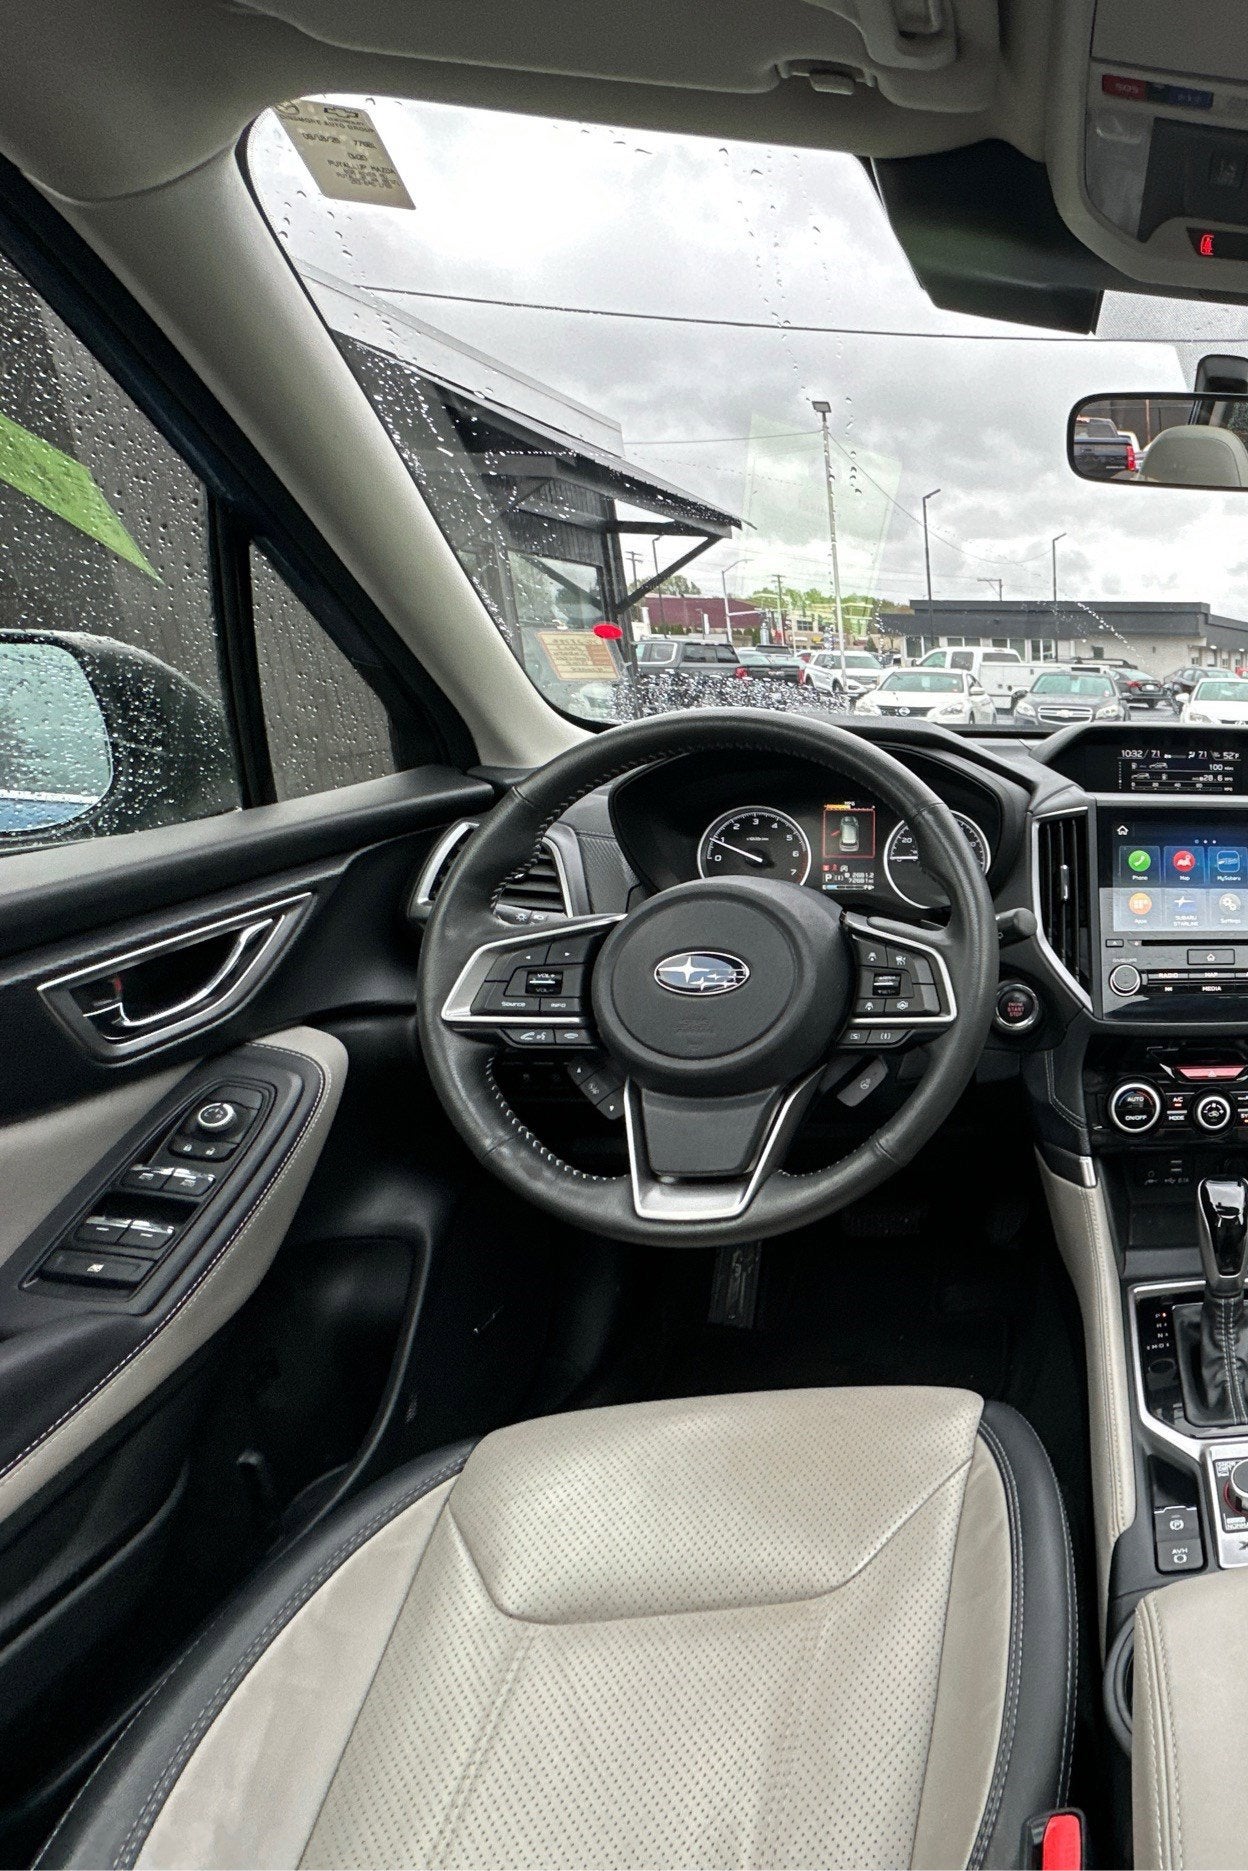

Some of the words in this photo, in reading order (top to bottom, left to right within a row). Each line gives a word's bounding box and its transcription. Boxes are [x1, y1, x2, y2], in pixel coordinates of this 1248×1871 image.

[1209, 763, 1224, 771] 100
[714, 854, 722, 862] 0
[790, 868, 797, 876] 7
